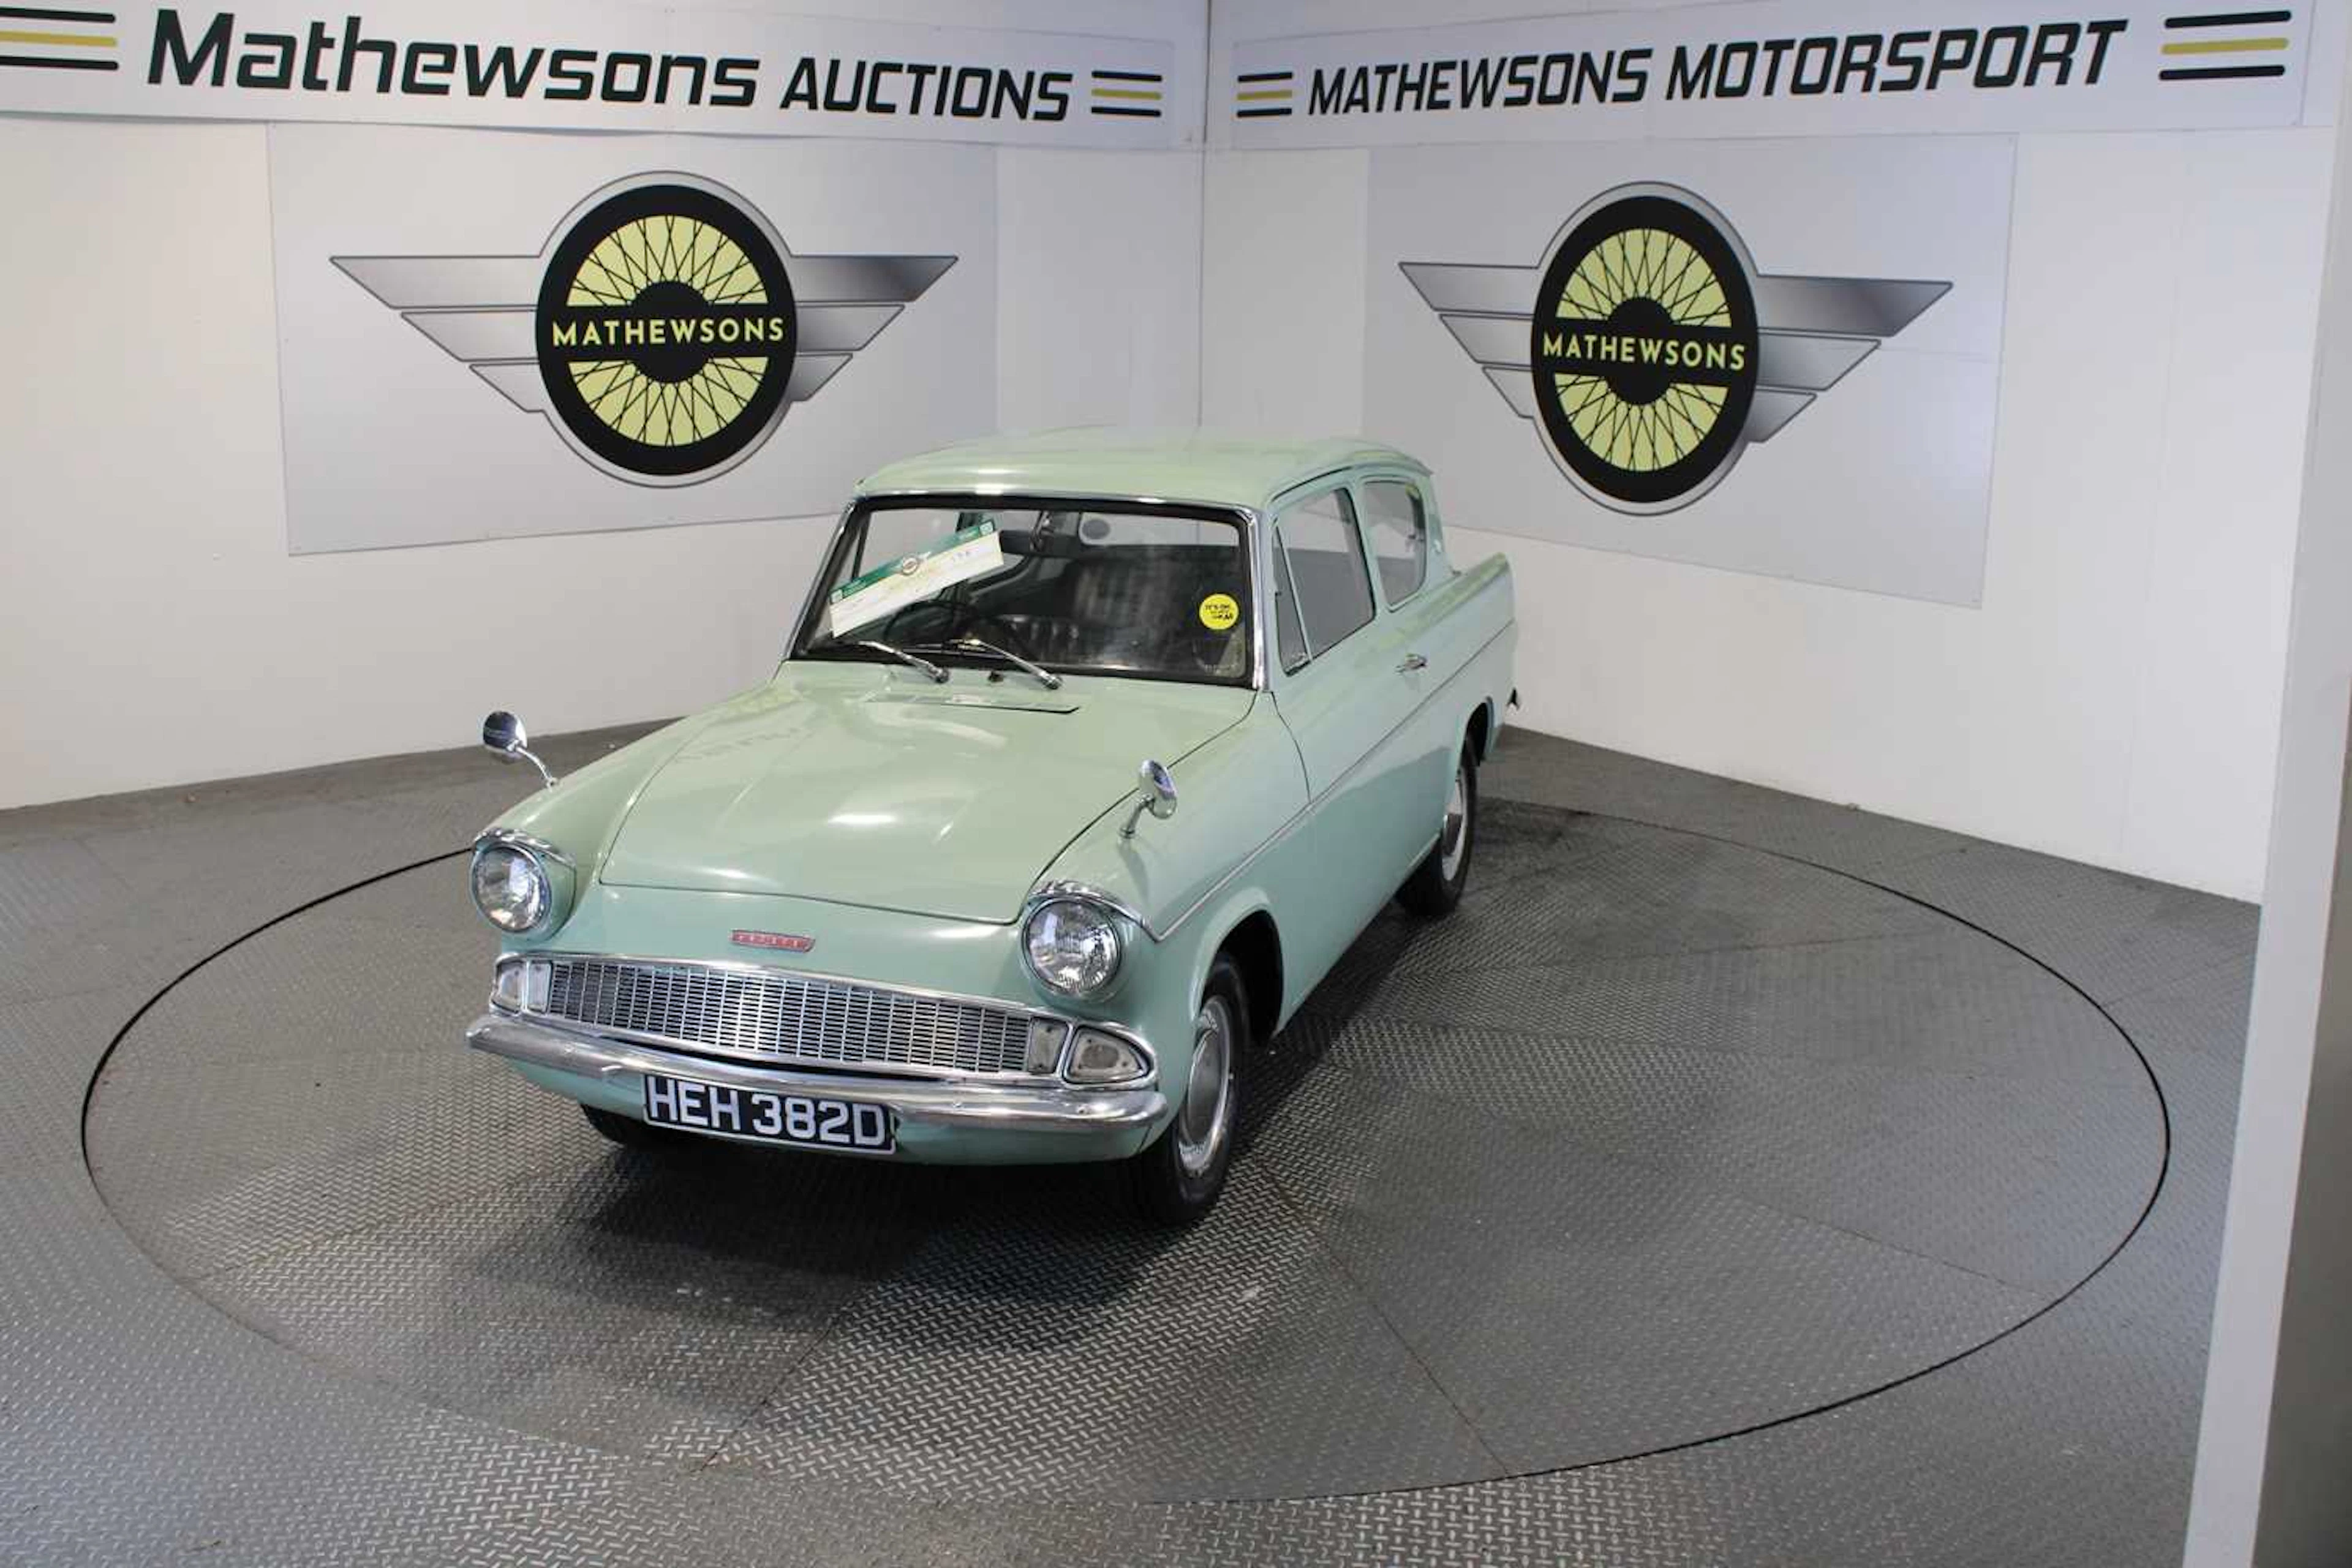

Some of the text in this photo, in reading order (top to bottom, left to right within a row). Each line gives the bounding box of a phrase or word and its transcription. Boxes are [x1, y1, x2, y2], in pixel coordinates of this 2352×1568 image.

[148, 9, 1072, 121] Mathewsons AUCTIONS
[1308, 20, 2128, 115] MATHEWSONS MOTORSPORT
[552, 317, 784, 347] MATHEWSONS
[1543, 332, 1746, 370] MATHEWSONS
[647, 1076, 884, 1145] HEH 382D
